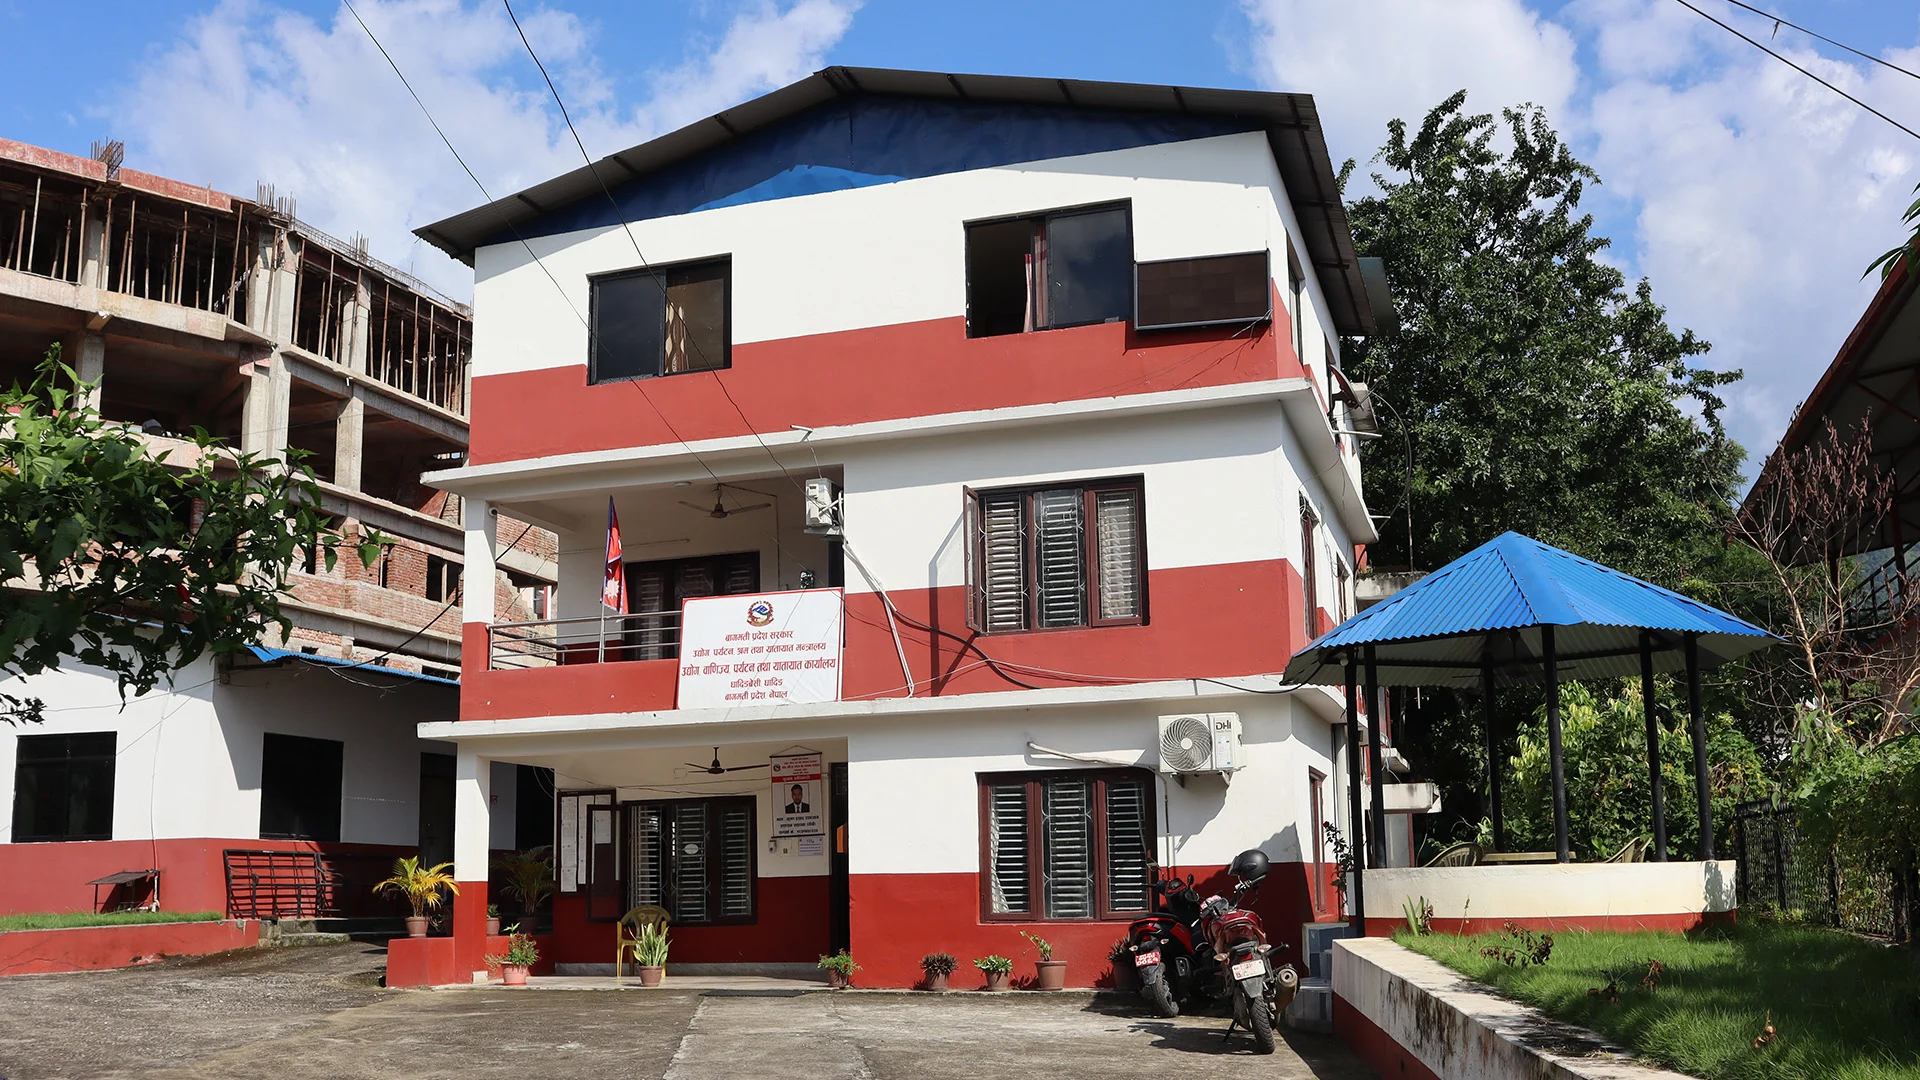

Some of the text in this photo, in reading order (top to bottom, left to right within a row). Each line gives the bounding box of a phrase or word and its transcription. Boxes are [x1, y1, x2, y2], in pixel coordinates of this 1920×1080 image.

[725, 630, 793, 642] बागमती प्रदेश सरकार
[751, 645, 764, 654] तथा
[766, 644, 794, 653] यातायात
[733, 661, 755, 672] पर्यटन
[757, 662, 770, 672] तथा
[773, 660, 802, 671] यातायात
[804, 657, 836, 669] कार्यालय
[725, 691, 749, 701] बागमती
[769, 690, 788, 699] नेपाल
